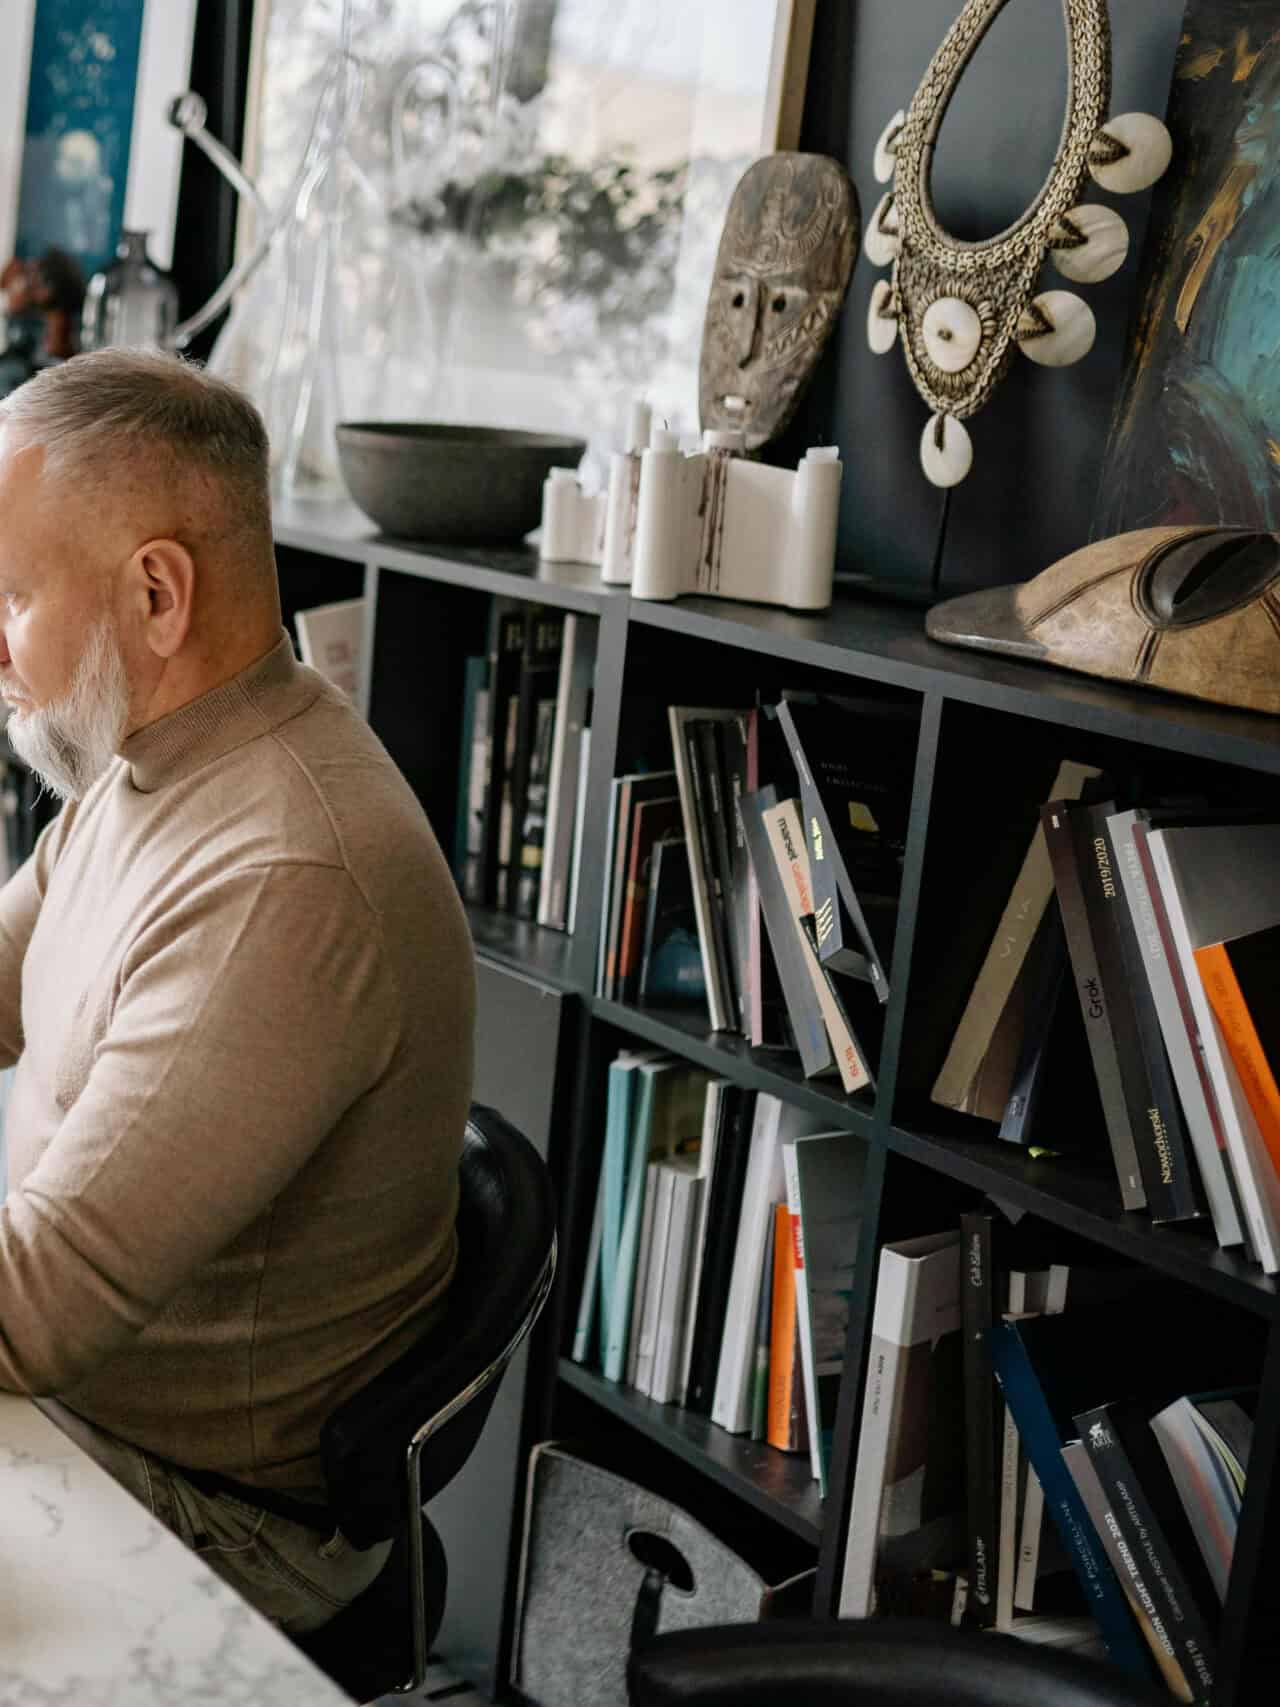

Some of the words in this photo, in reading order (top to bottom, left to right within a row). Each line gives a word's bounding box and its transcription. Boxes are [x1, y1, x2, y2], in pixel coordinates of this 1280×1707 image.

[777, 817, 798, 861] marset
[1094, 837, 1116, 899] 2019/2020
[1084, 977, 1104, 1019] Grok
[1104, 1511, 1121, 1539] 2021
[1117, 1541, 1139, 1579] TREND
[1135, 1580, 1156, 1615] LIGHT
[1151, 1615, 1175, 1657] ODEON
